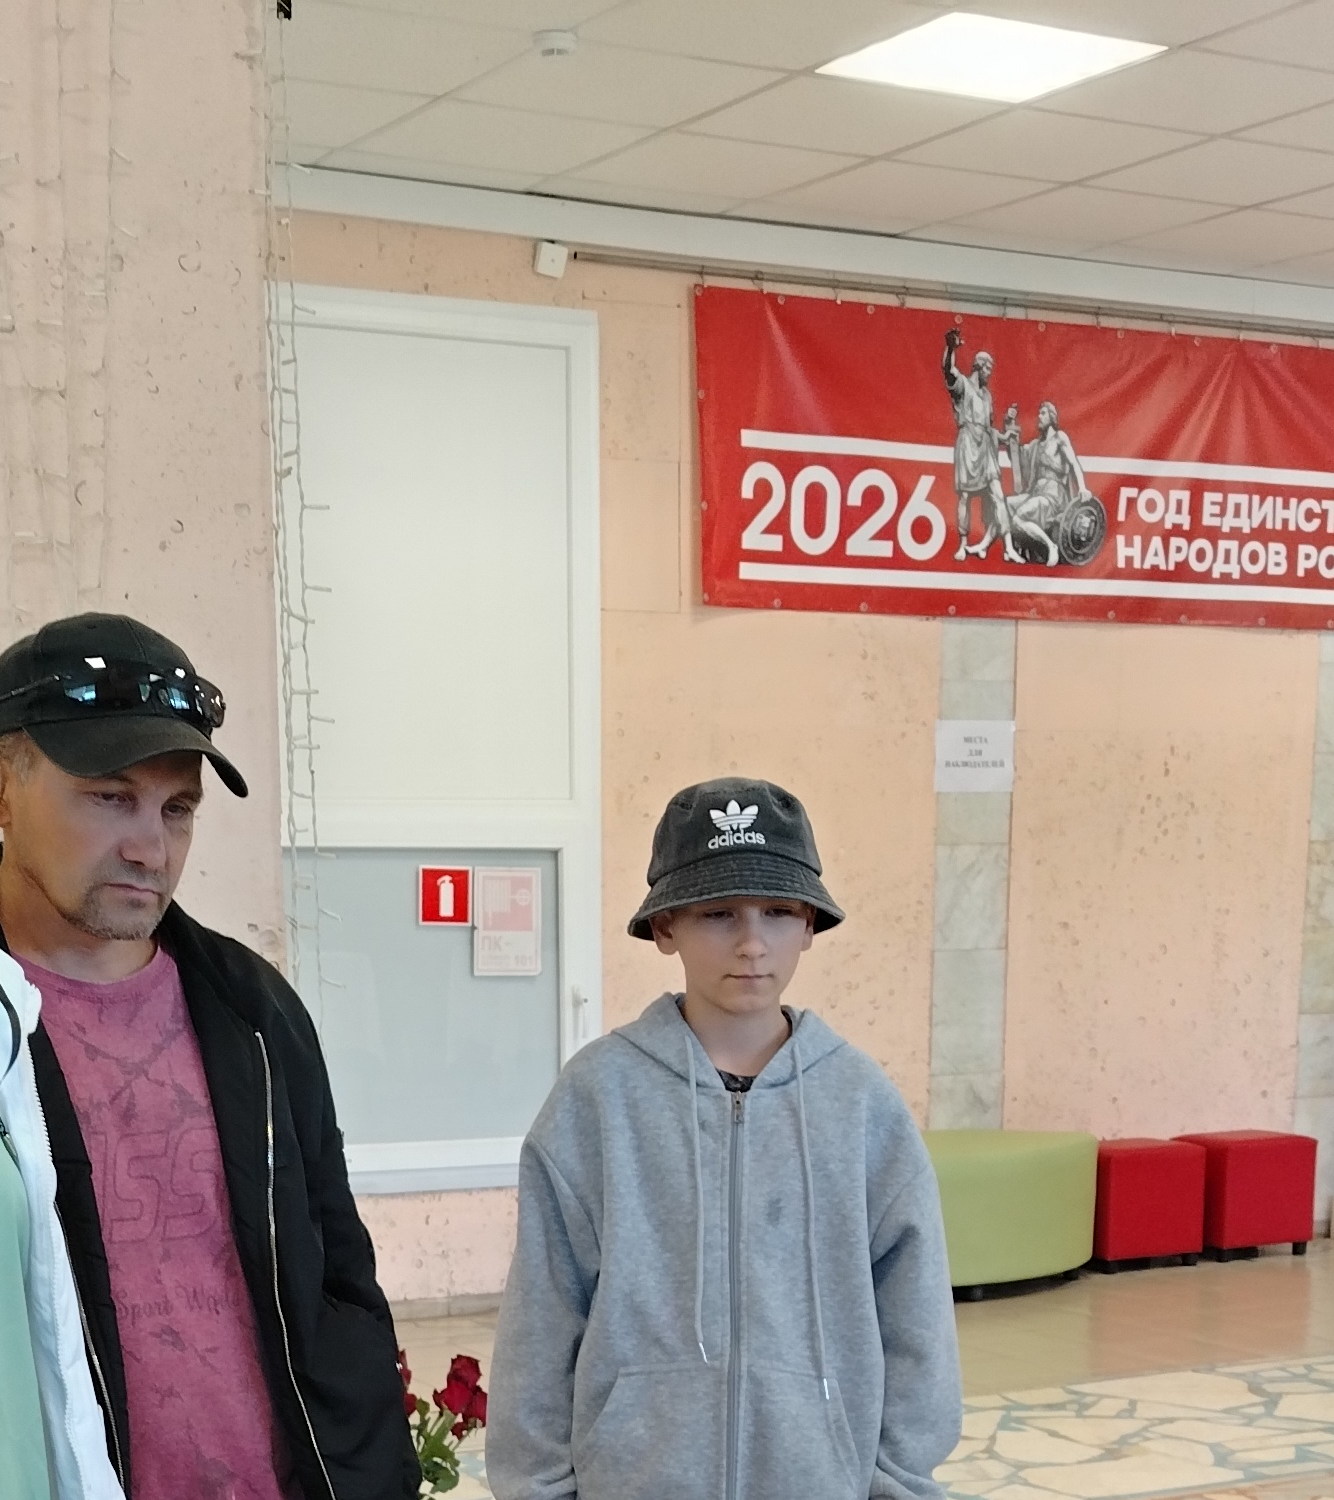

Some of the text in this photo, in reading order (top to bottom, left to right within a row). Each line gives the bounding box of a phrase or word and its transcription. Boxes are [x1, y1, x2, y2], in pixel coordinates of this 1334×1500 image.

[741, 461, 947, 561] 2026
[1117, 486, 1191, 531] ГОД
[1116, 534, 1288, 580] НАРОДОВ
[708, 830, 765, 849] adidas
